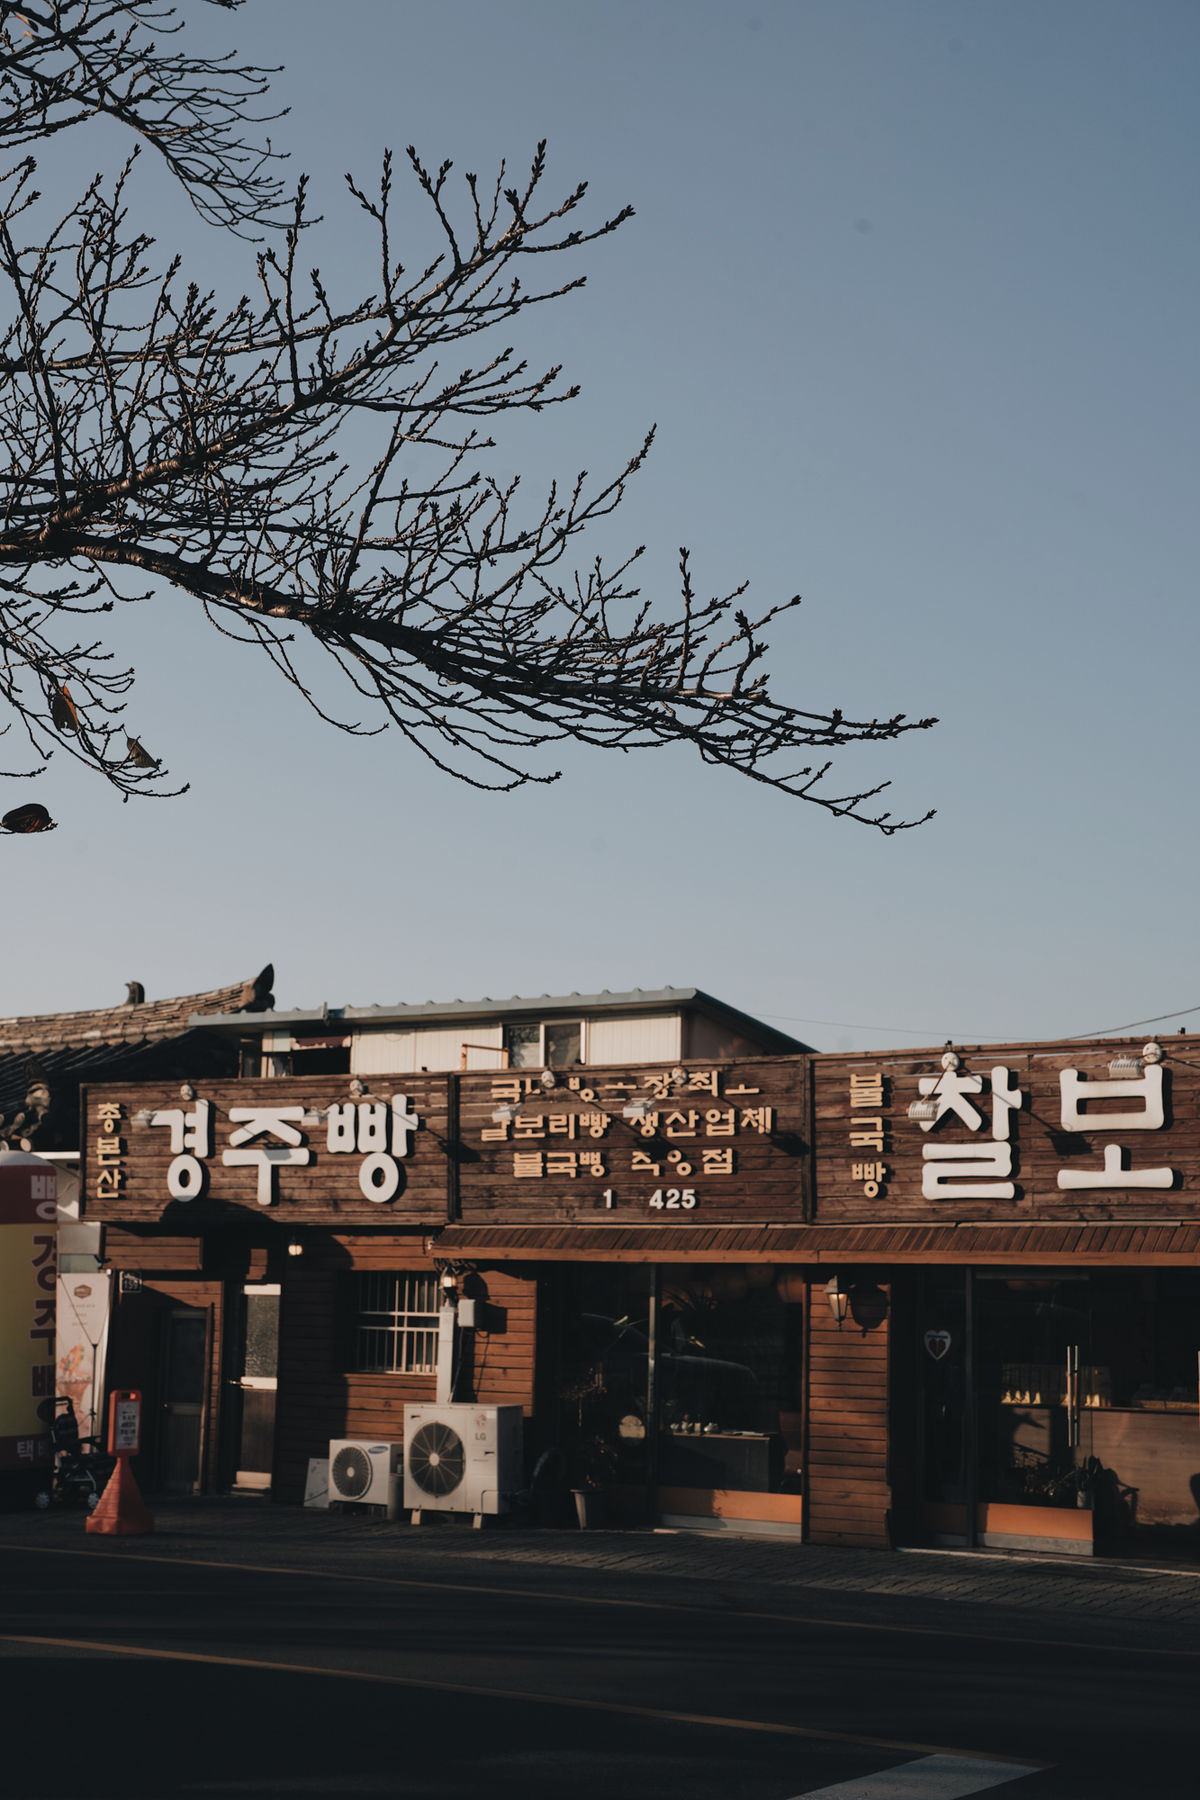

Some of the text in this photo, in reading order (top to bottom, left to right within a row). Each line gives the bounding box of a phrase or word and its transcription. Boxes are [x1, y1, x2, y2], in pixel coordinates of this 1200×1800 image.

[96, 1102, 122, 1198] 총본산
[149, 1093, 419, 1205] 경주빵
[630, 1106, 772, 1138] 생산업체
[849, 1072, 886, 1198] 불국빵
[918, 1064, 1174, 1200] 찰보
[649, 1188, 697, 1210] 425
[475, 1432, 487, 1441] LG
